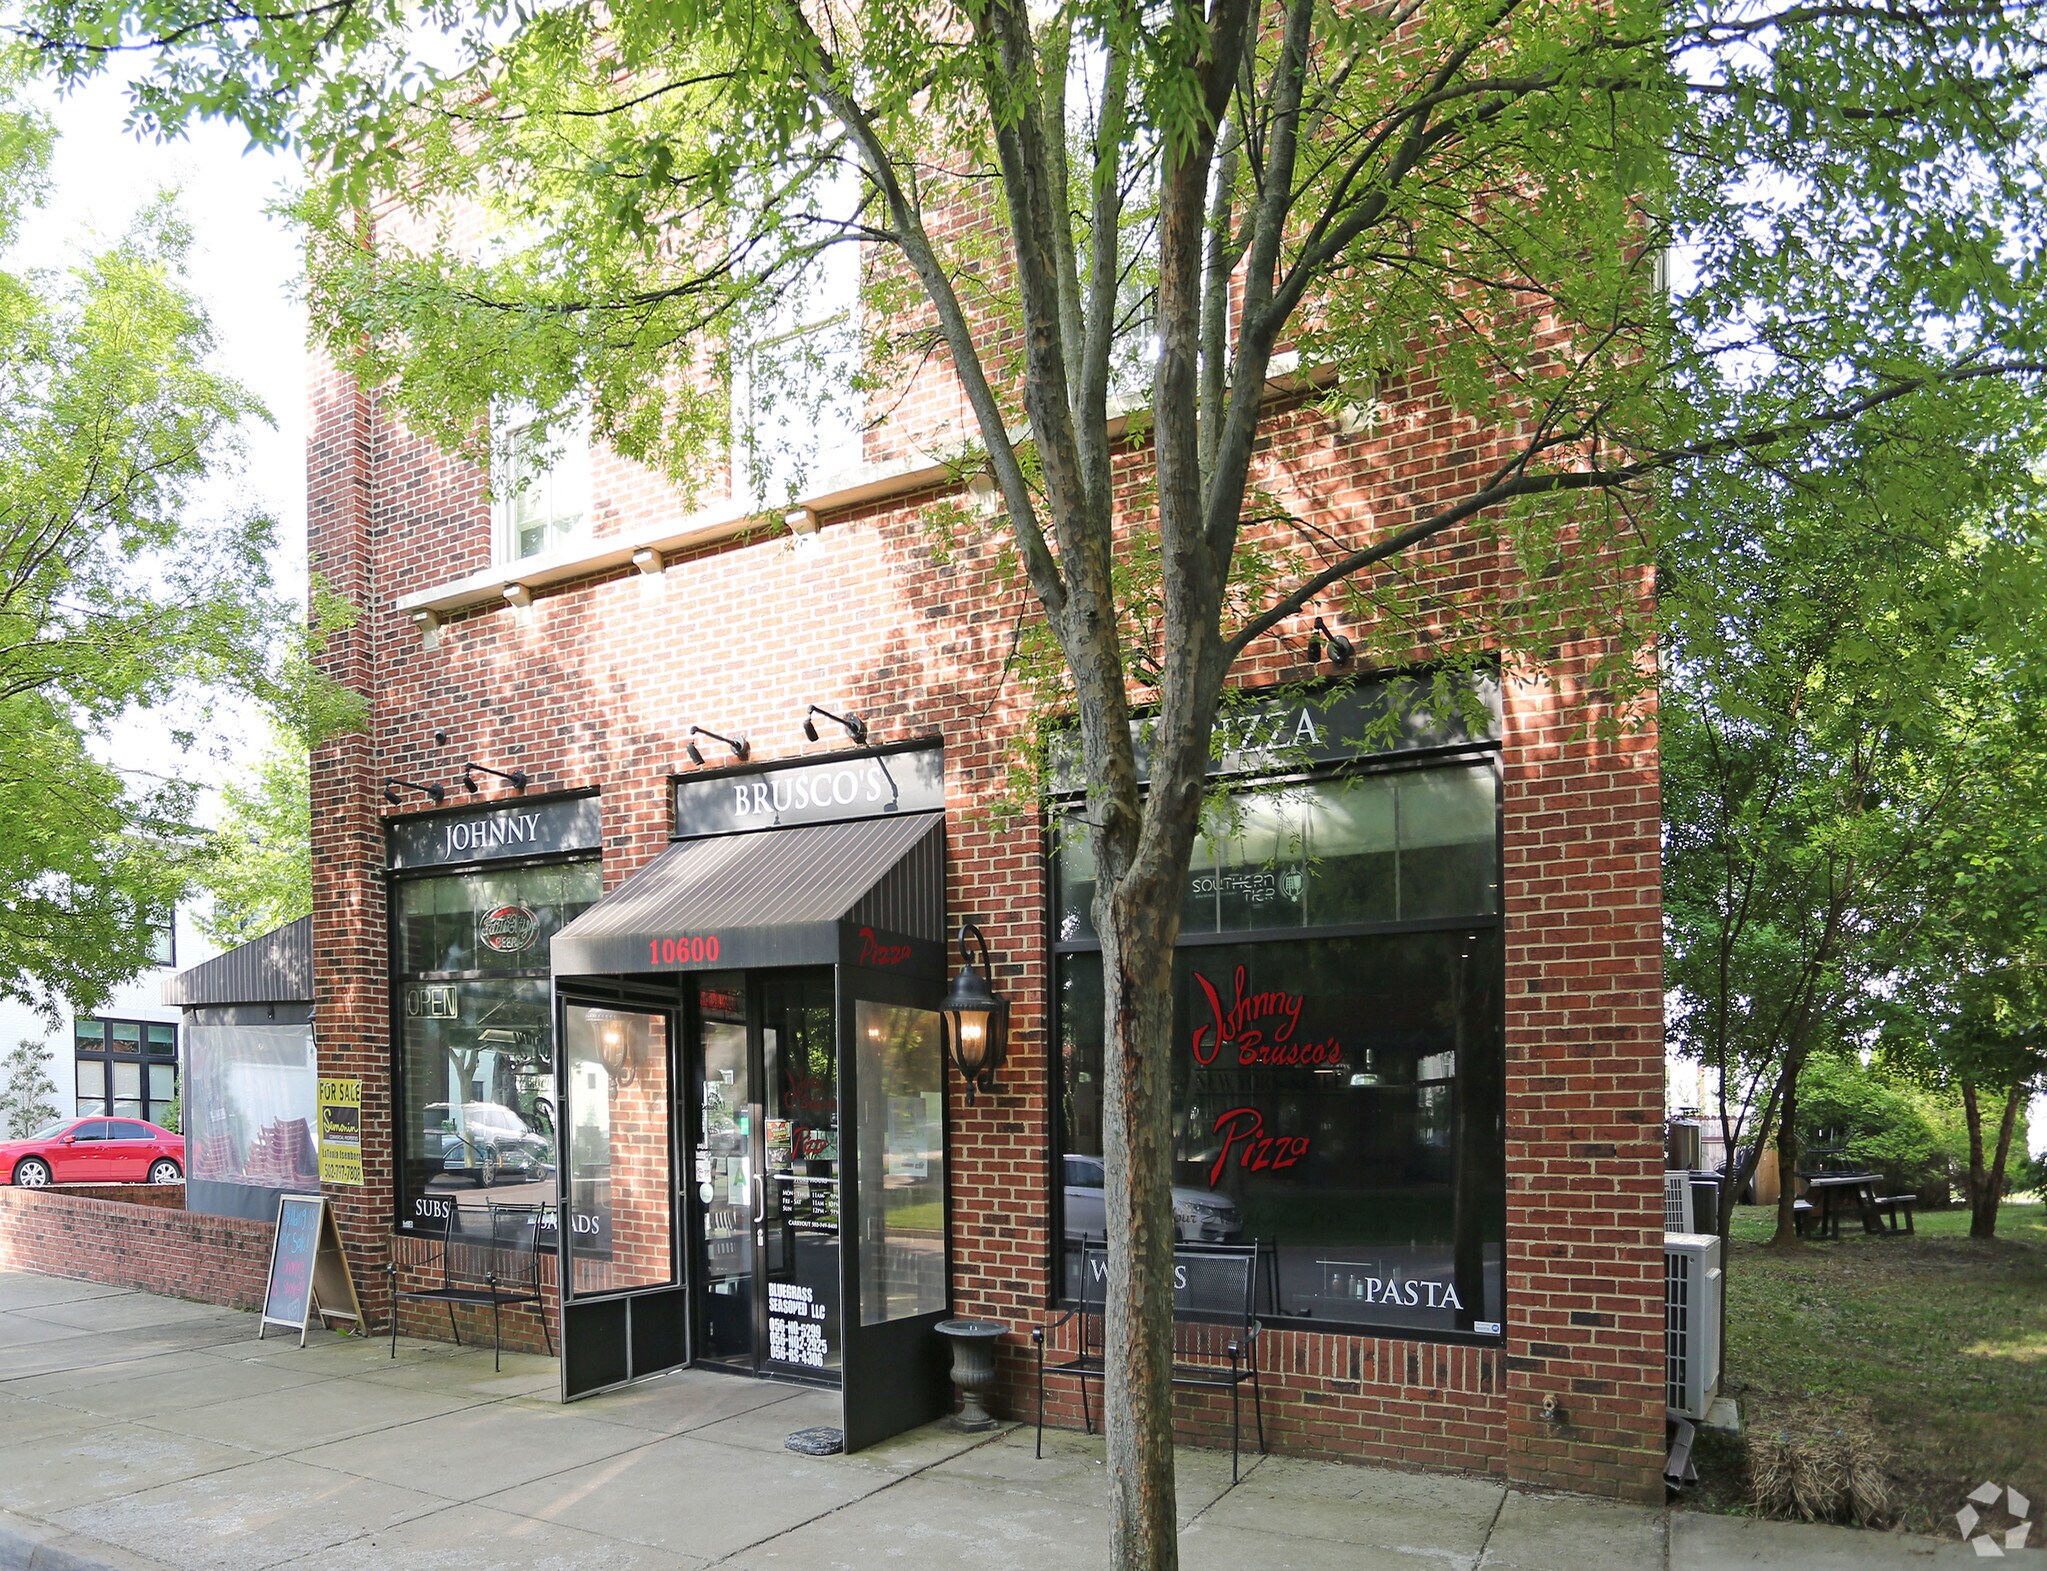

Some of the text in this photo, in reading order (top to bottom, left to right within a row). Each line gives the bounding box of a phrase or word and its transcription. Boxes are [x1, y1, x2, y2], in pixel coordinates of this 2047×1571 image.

[1211, 707, 1323, 756] IZZA
[732, 765, 883, 817] BRUSCO'S
[444, 812, 541, 859] JOHNNY
[495, 936, 523, 949] BEER
[649, 935, 720, 965] 10600
[858, 927, 912, 966] Pizza
[408, 988, 456, 1016] OPEN
[1191, 964, 1306, 1066] Johnny
[1237, 1030, 1344, 1067] Brusco's
[320, 1082, 360, 1102] FOR SALE
[1210, 1107, 1310, 1189] Pizza
[415, 1198, 449, 1218] SUBS
[540, 1211, 600, 1235] SAADS
[768, 1282, 813, 1303] BLUEGRASS
[1364, 1275, 1464, 1311] PASTA
[811, 1304, 826, 1320] LLC
